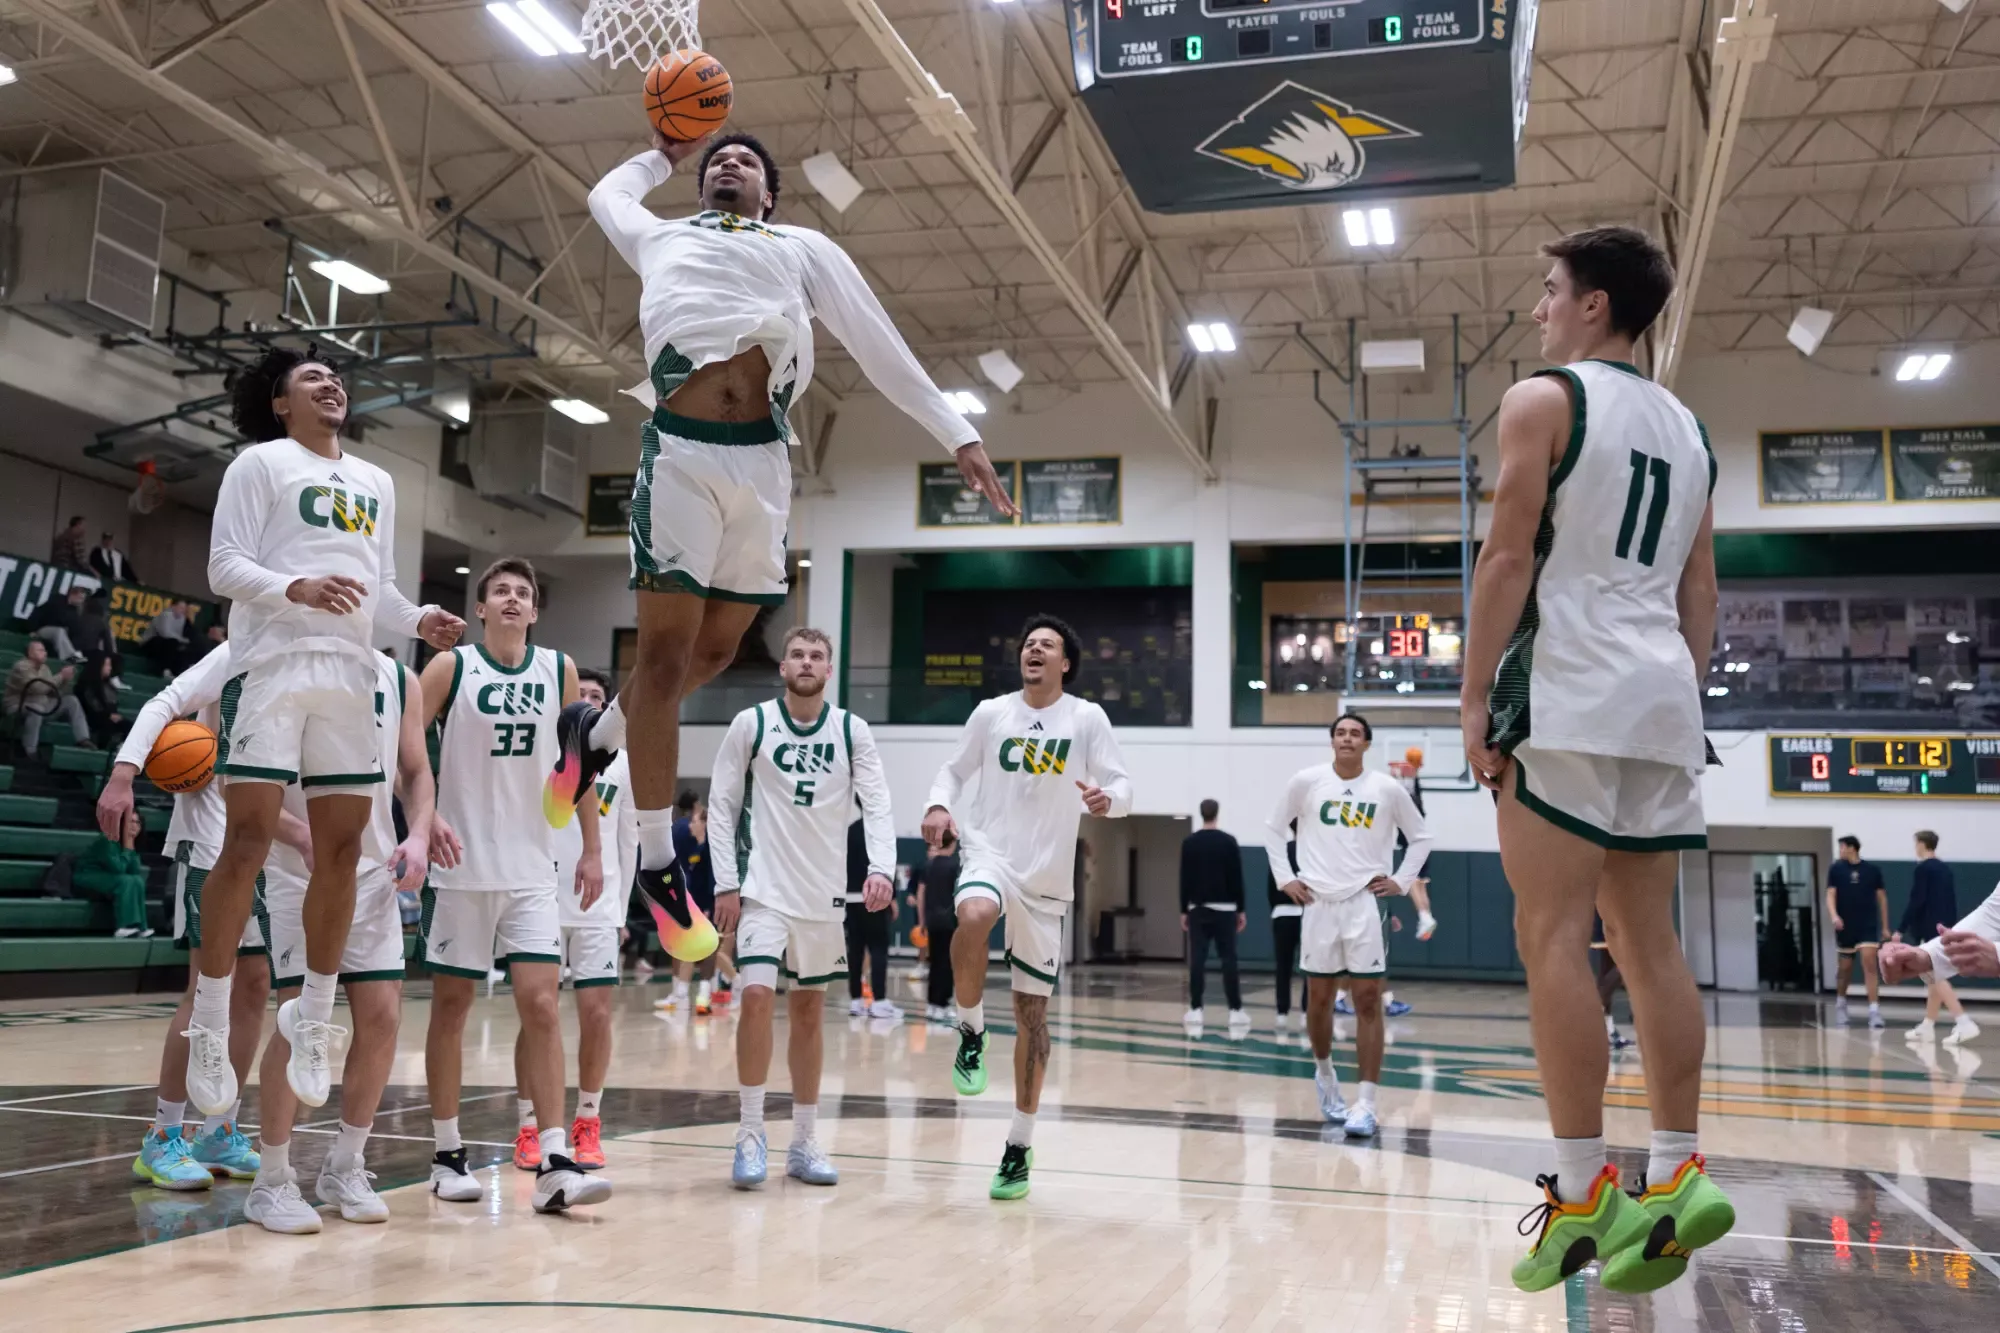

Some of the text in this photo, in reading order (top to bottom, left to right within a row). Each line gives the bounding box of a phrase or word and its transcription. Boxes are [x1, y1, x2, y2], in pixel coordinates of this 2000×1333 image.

[1143, 3, 1177, 17] LEFT
[1227, 7, 1346, 29] PLAYER FOULS
[1415, 12, 1455, 27] TEAM
[1385, 16, 1402, 42] 0
[1412, 23, 1460, 39] FOULS
[1118, 52, 1163, 68] FOULS
[1121, 40, 1158, 55] TEAM
[1186, 35, 1202, 61] 0
[1925, 485, 1986, 498] SOFTBALL
[299, 485, 379, 537] CUI
[1615, 448, 1671, 567] 11
[1389, 630, 1423, 657] 30
[477, 682, 545, 716] CUI
[490, 723, 536, 757] 33
[1782, 738, 1833, 753] EAGLES
[772, 742, 835, 775] CUI
[999, 737, 1072, 776] CUI
[1811, 753, 1829, 780] 0
[1885, 741, 1943, 767] 1:12
[793, 780, 816, 807] 5
[1921, 773, 1929, 794] 1
[1320, 799, 1376, 829] CUI
